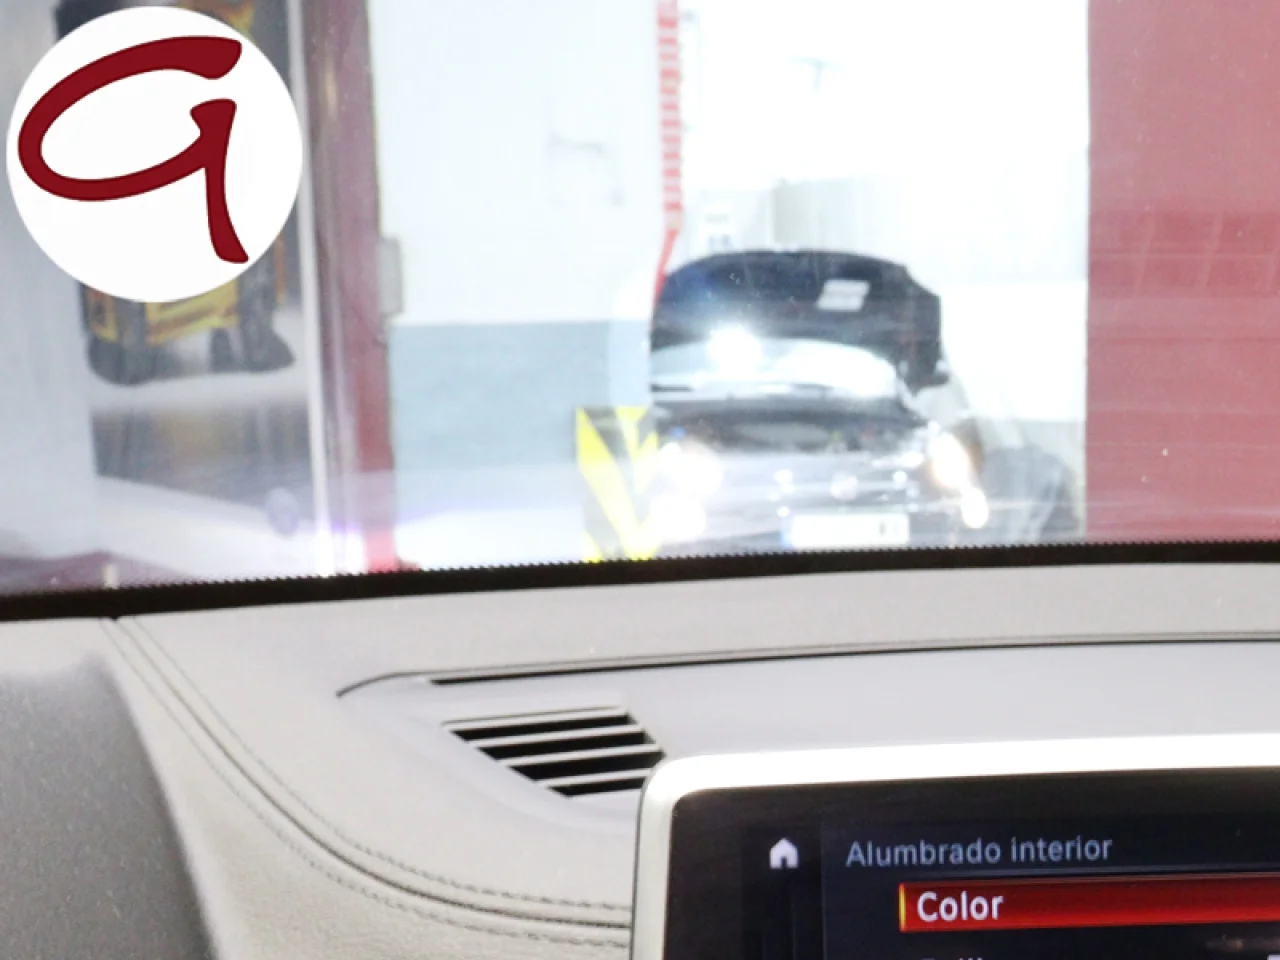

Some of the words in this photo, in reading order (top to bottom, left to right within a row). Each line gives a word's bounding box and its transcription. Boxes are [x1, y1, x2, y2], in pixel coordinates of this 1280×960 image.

[845, 838, 1001, 867] Alumbrado
[1010, 835, 1113, 863] interior
[917, 890, 1004, 922] Color
